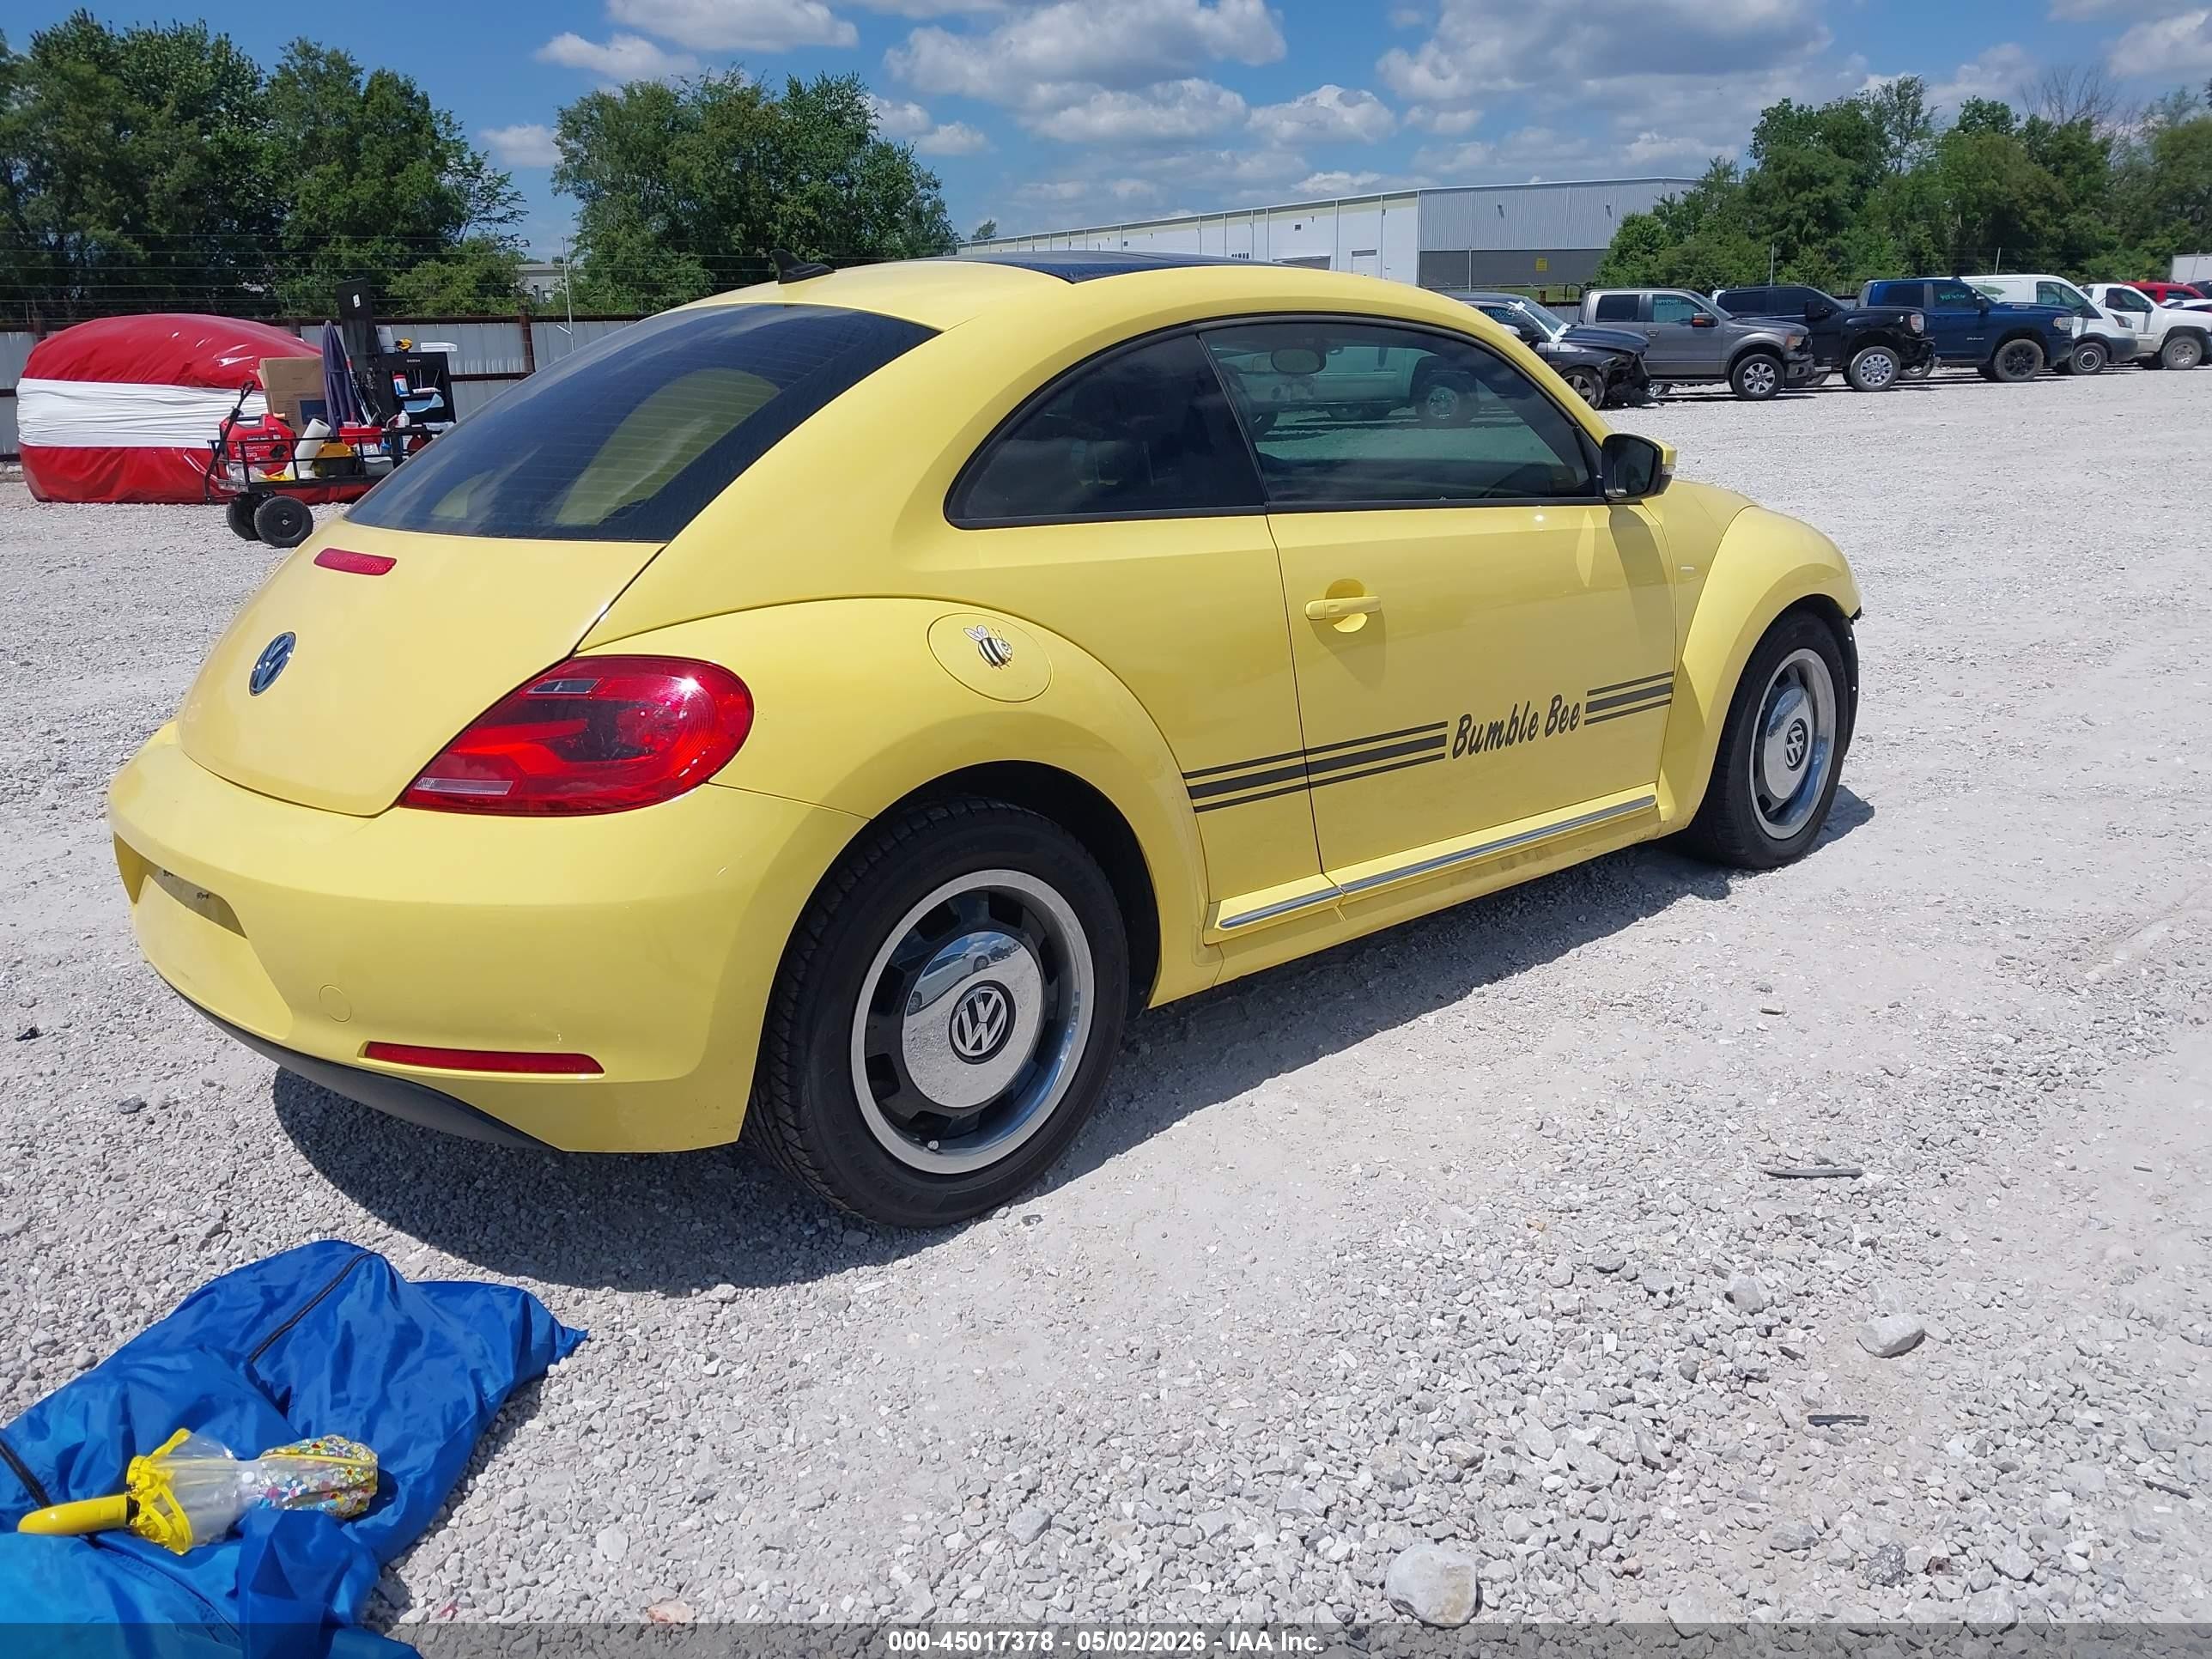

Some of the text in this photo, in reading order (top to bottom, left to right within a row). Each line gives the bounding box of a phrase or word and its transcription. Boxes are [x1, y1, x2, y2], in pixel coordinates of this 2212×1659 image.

[1452, 694, 1581, 760] Bumble Bee
[952, 987, 1007, 1056] VW
